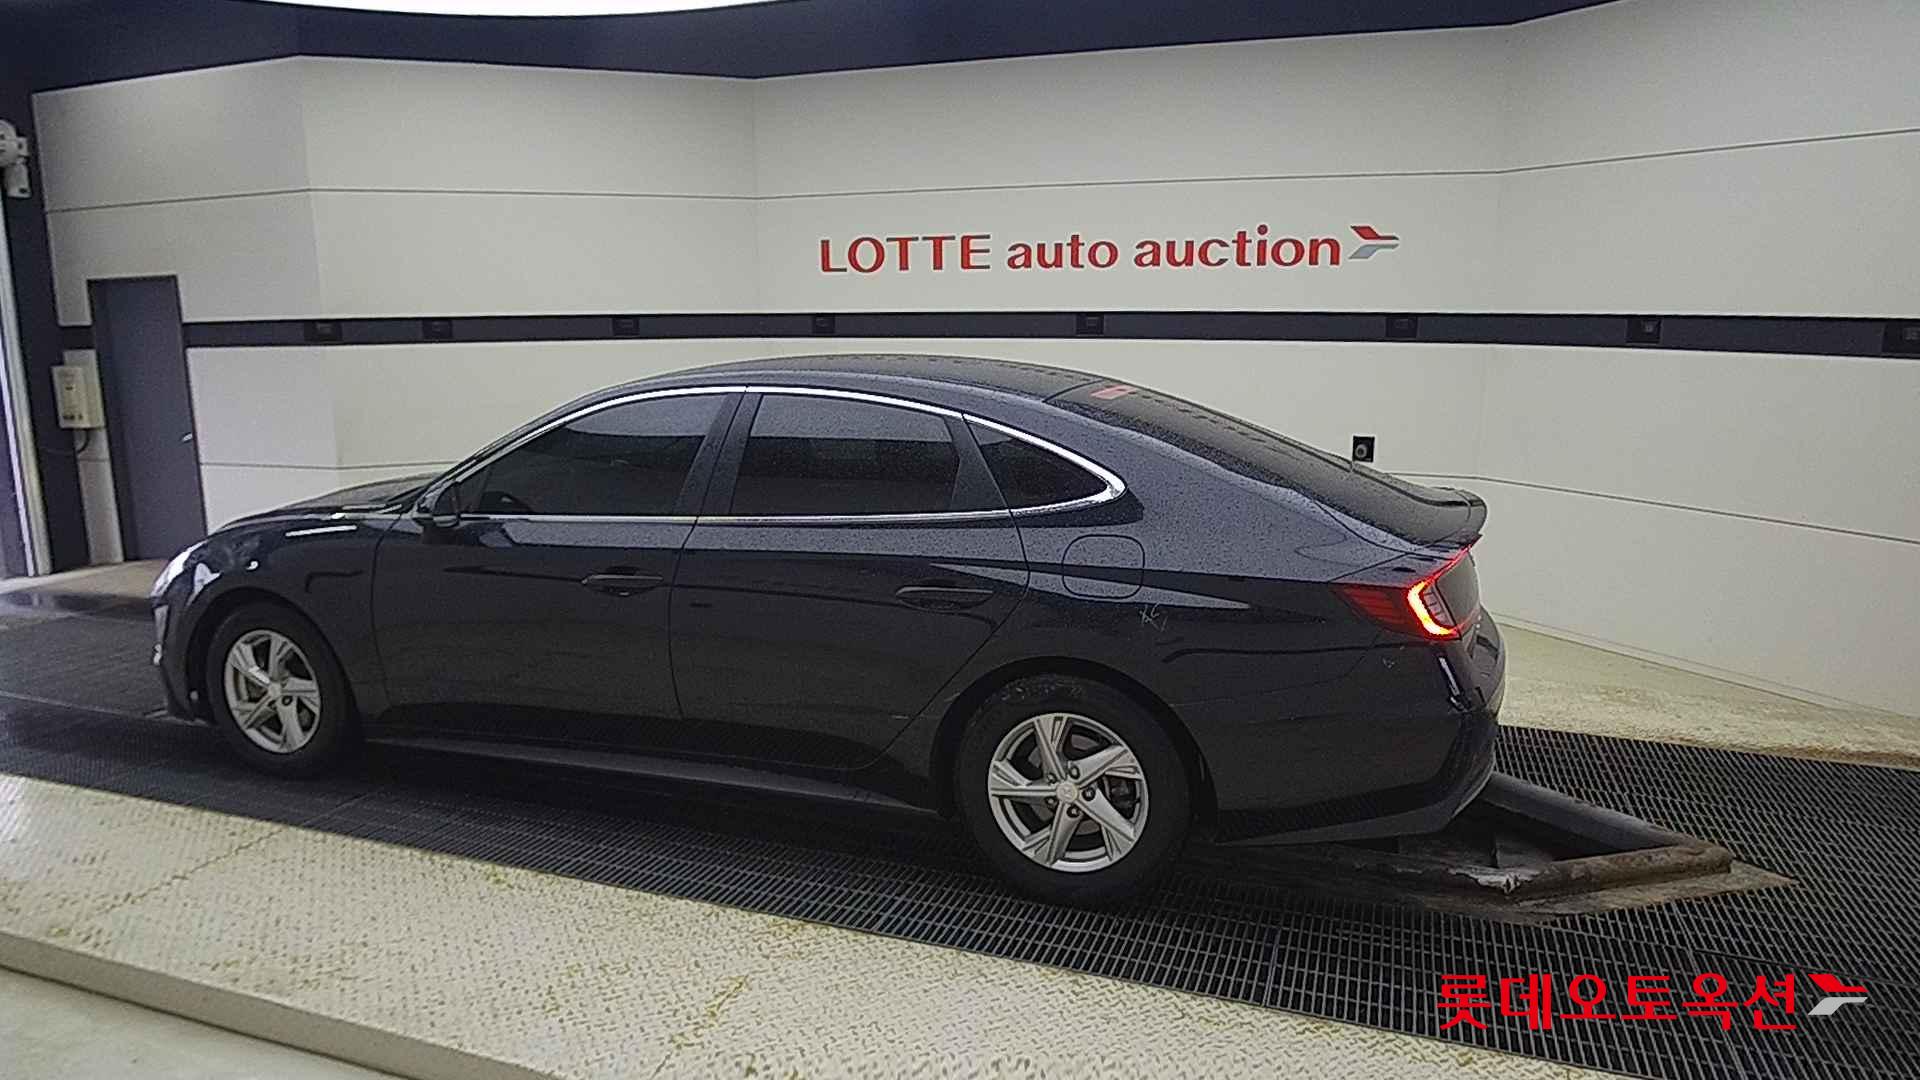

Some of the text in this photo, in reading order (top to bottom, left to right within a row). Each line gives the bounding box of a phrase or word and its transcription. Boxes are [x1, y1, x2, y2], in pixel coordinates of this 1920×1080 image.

[820, 225, 1341, 273] LOTTE auto auction
